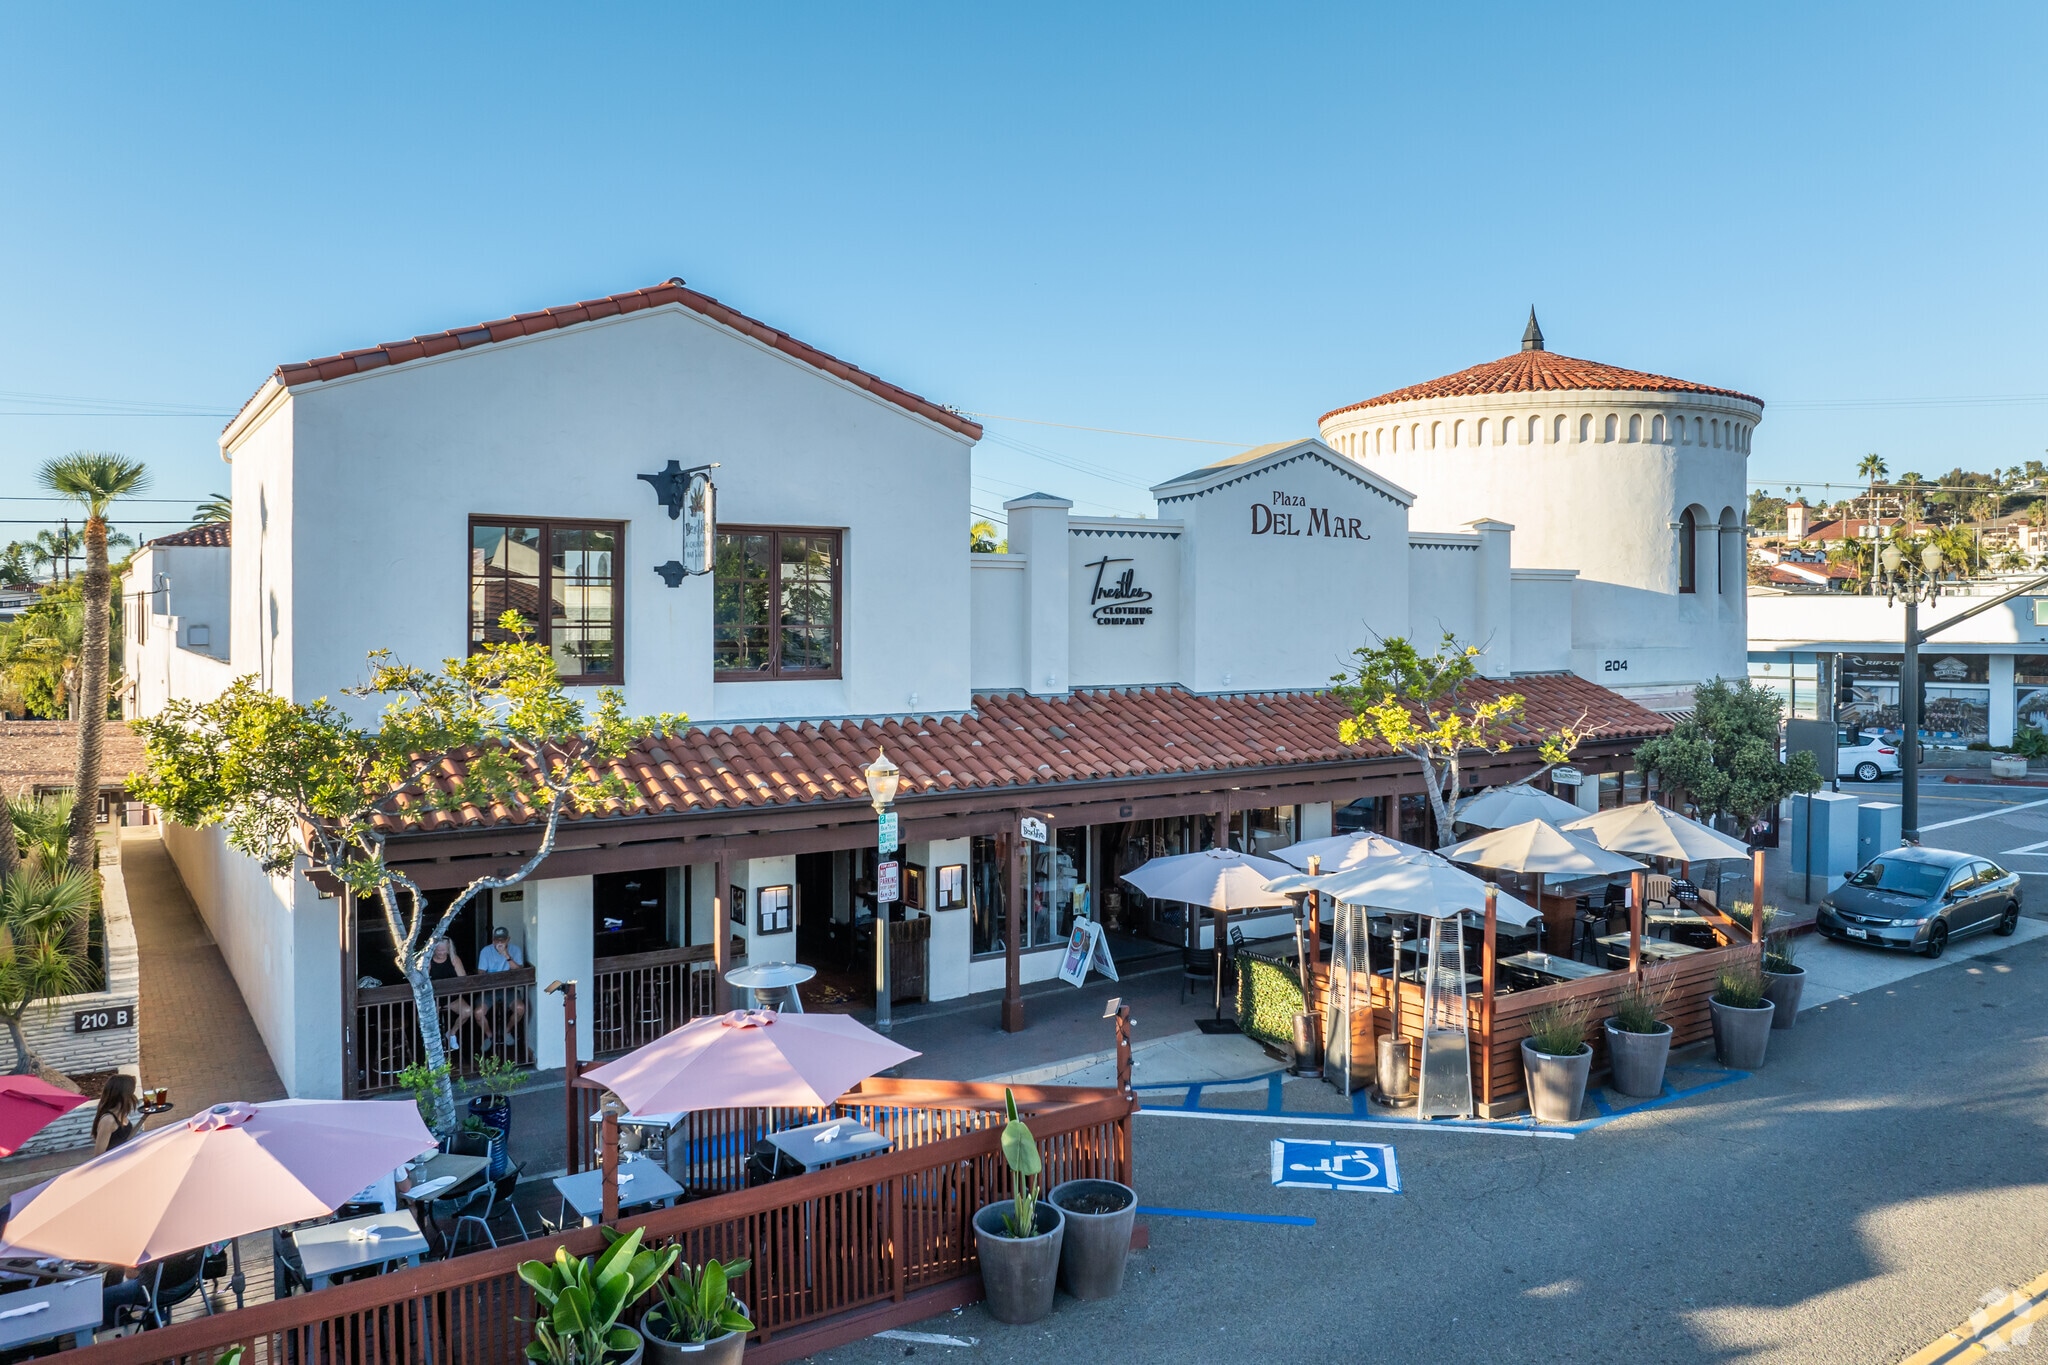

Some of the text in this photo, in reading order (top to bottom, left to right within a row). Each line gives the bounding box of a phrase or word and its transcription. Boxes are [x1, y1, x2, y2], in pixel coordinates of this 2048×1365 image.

[1273, 490, 1306, 507] Plaza
[1250, 503, 1371, 541] DEL MAR
[1084, 555, 1153, 606] Trestles
[1102, 606, 1153, 615] CLOTHING
[1096, 617, 1146, 625] COMPANY
[1604, 660, 1628, 672] 204
[1119, 805, 1133, 818] C
[81, 1010, 128, 1030] 210 B
